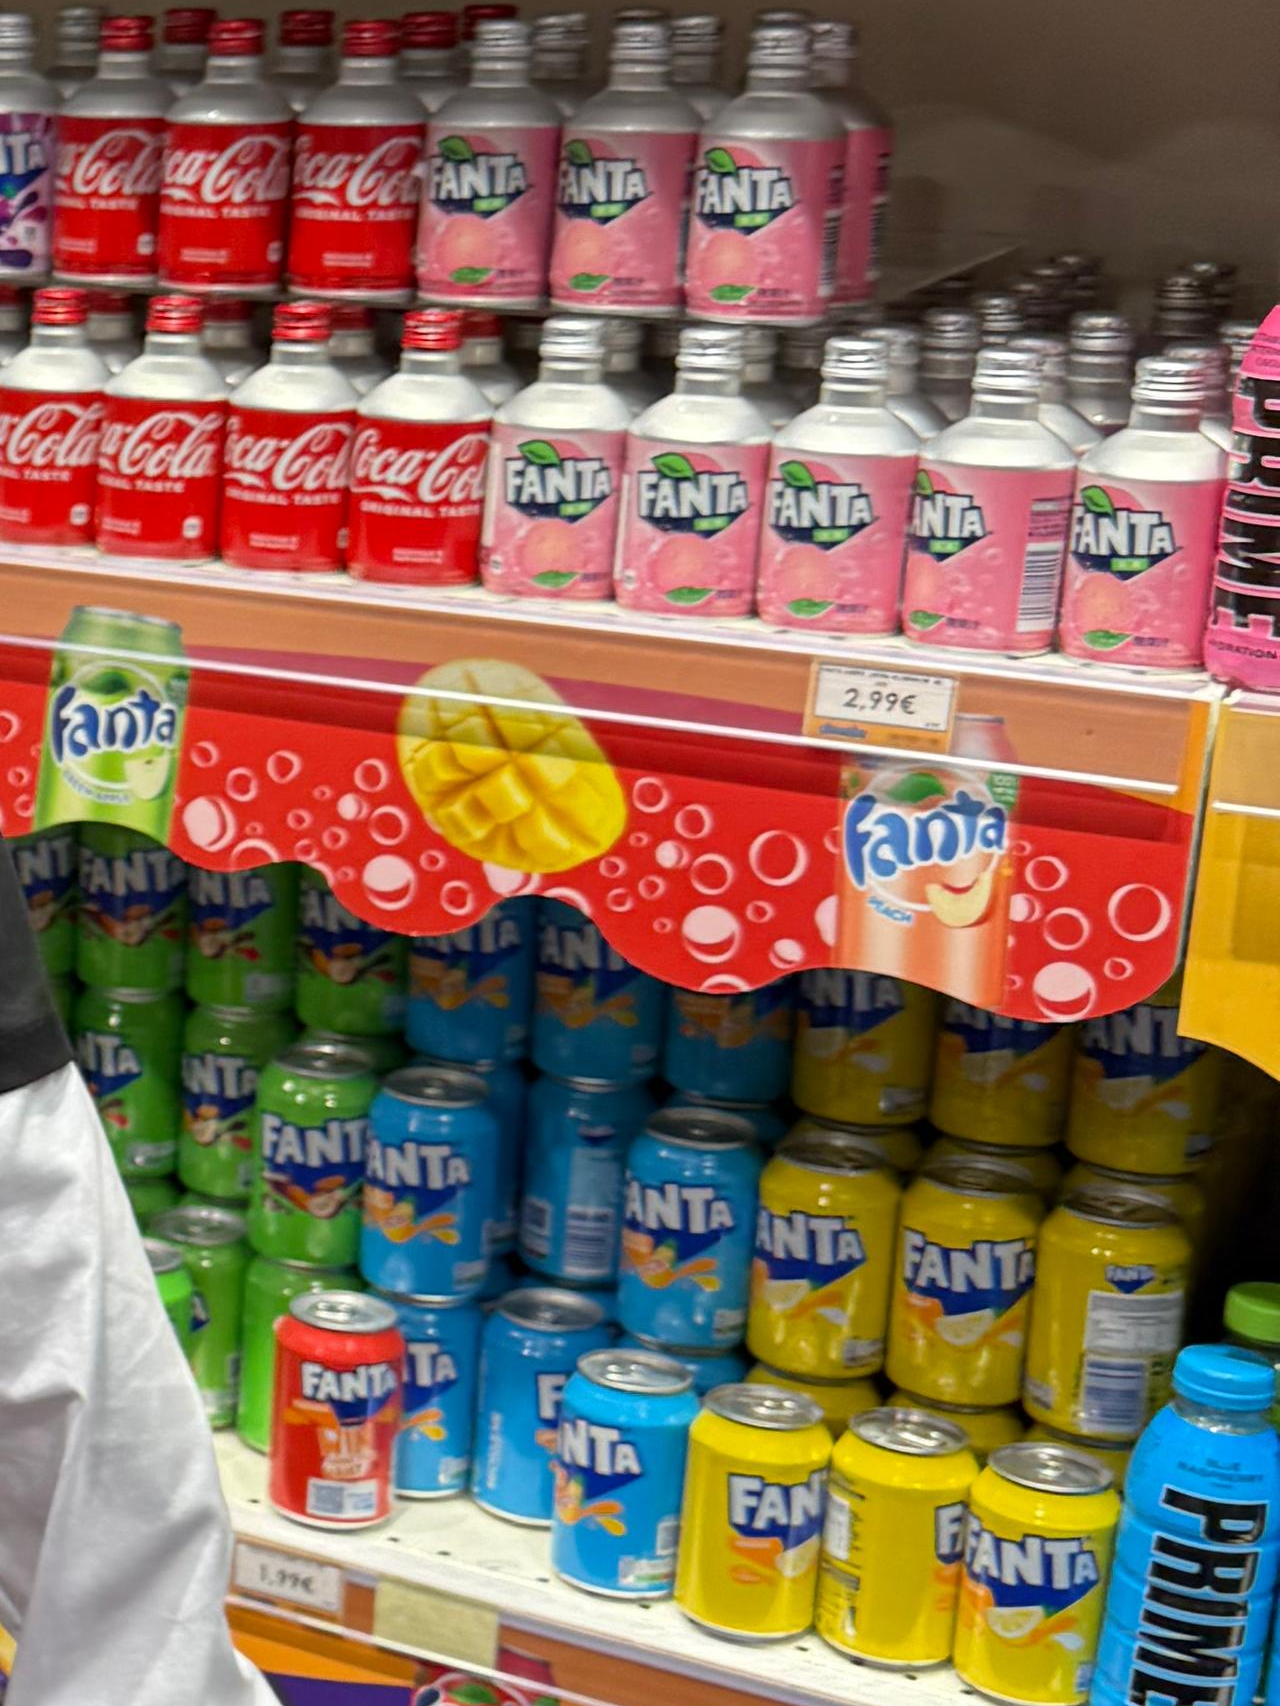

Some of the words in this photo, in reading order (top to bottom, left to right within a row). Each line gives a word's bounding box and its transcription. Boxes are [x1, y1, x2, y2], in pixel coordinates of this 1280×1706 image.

[506, 459, 612, 505] FANTA
[639, 472, 748, 518] FANTA
[842, 687, 918, 715] 2,99€
[51, 685, 178, 765] Fanta
[843, 789, 1008, 889] Fanta
[300, 1362, 397, 1403] FANTA
